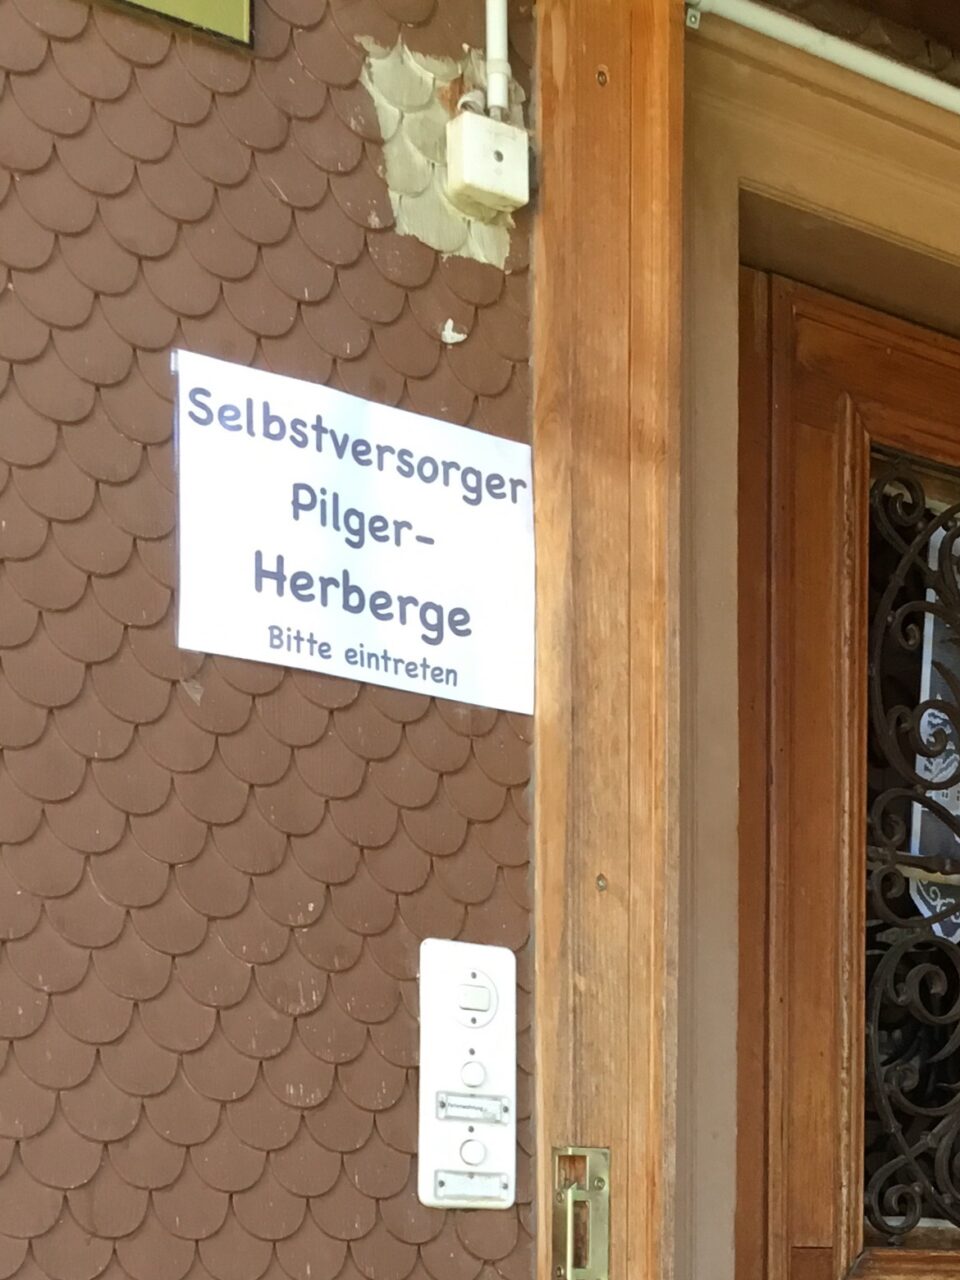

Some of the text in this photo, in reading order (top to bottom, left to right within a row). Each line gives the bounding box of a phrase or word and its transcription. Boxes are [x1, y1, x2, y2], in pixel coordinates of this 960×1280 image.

[188, 387, 528, 506] Selbstversorger
[291, 482, 435, 549] Pilger-
[254, 549, 473, 646] Herberge
[268, 624, 458, 687] Bitte eintreten
